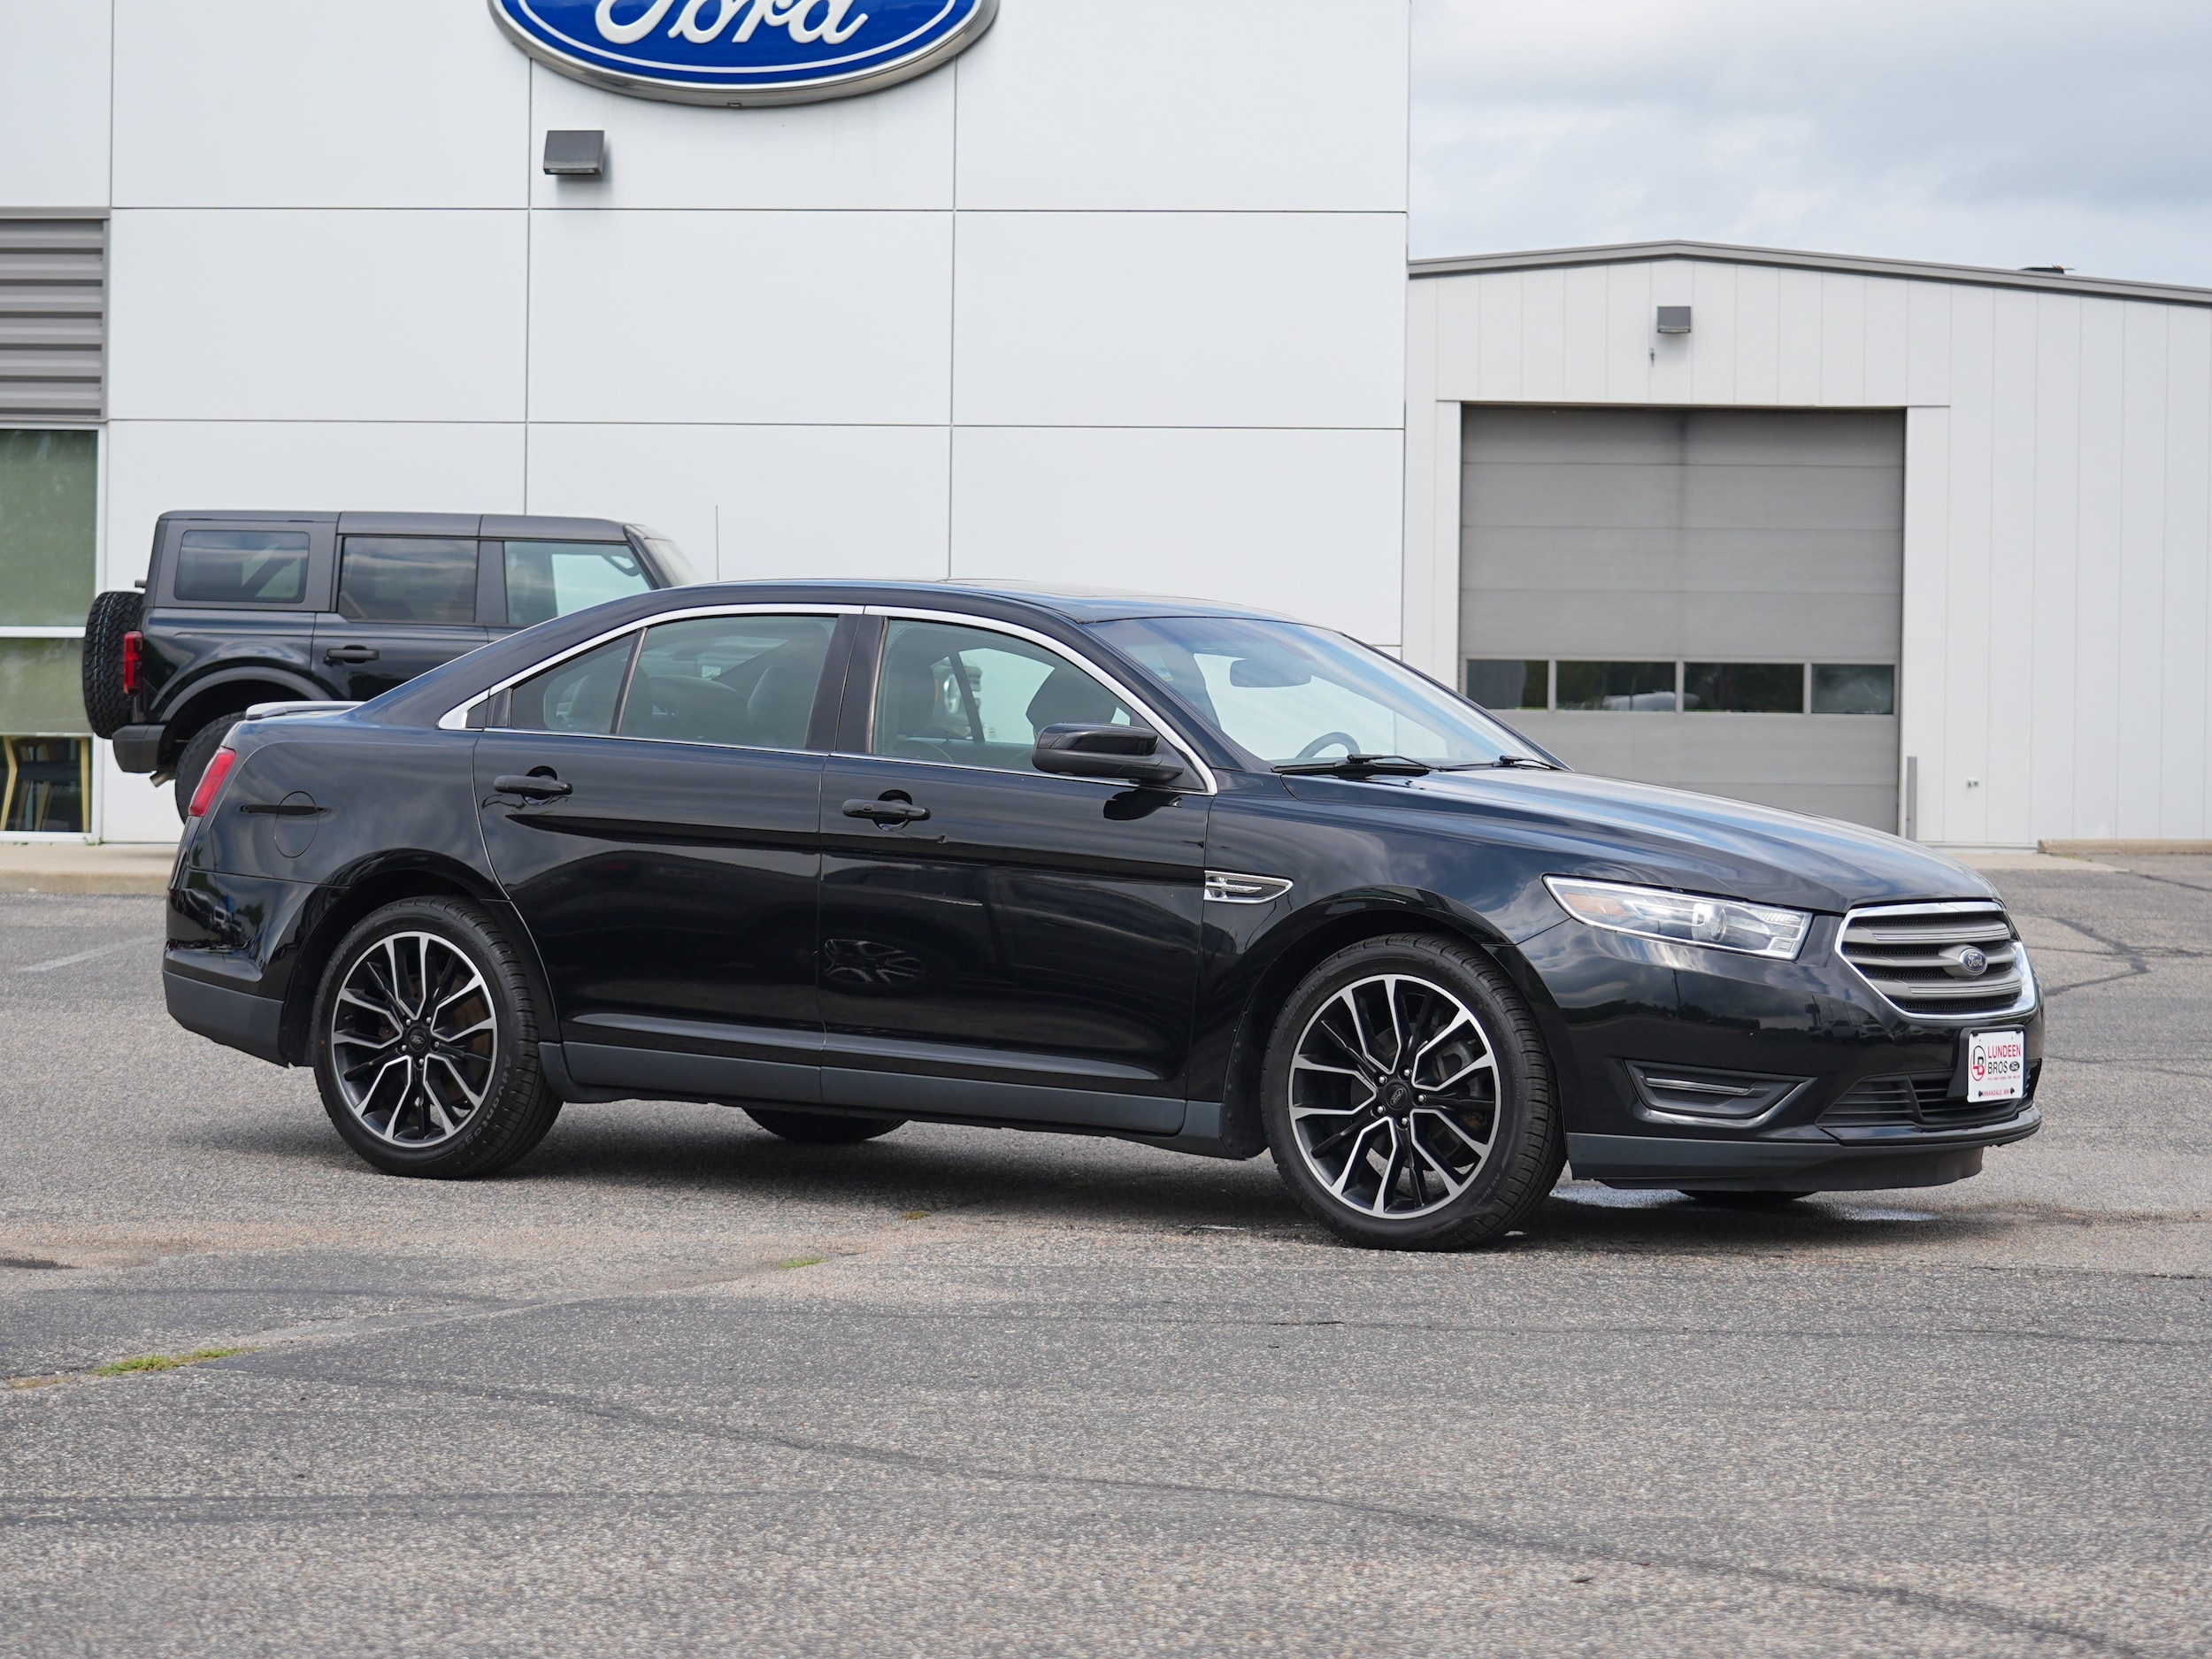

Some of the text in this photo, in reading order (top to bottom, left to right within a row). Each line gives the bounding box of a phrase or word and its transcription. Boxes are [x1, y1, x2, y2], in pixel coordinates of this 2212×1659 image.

[1967, 952, 1983, 967] Ford
[1987, 1044, 2021, 1059] LUNDEEN
[1987, 1061, 2008, 1074] BROS
